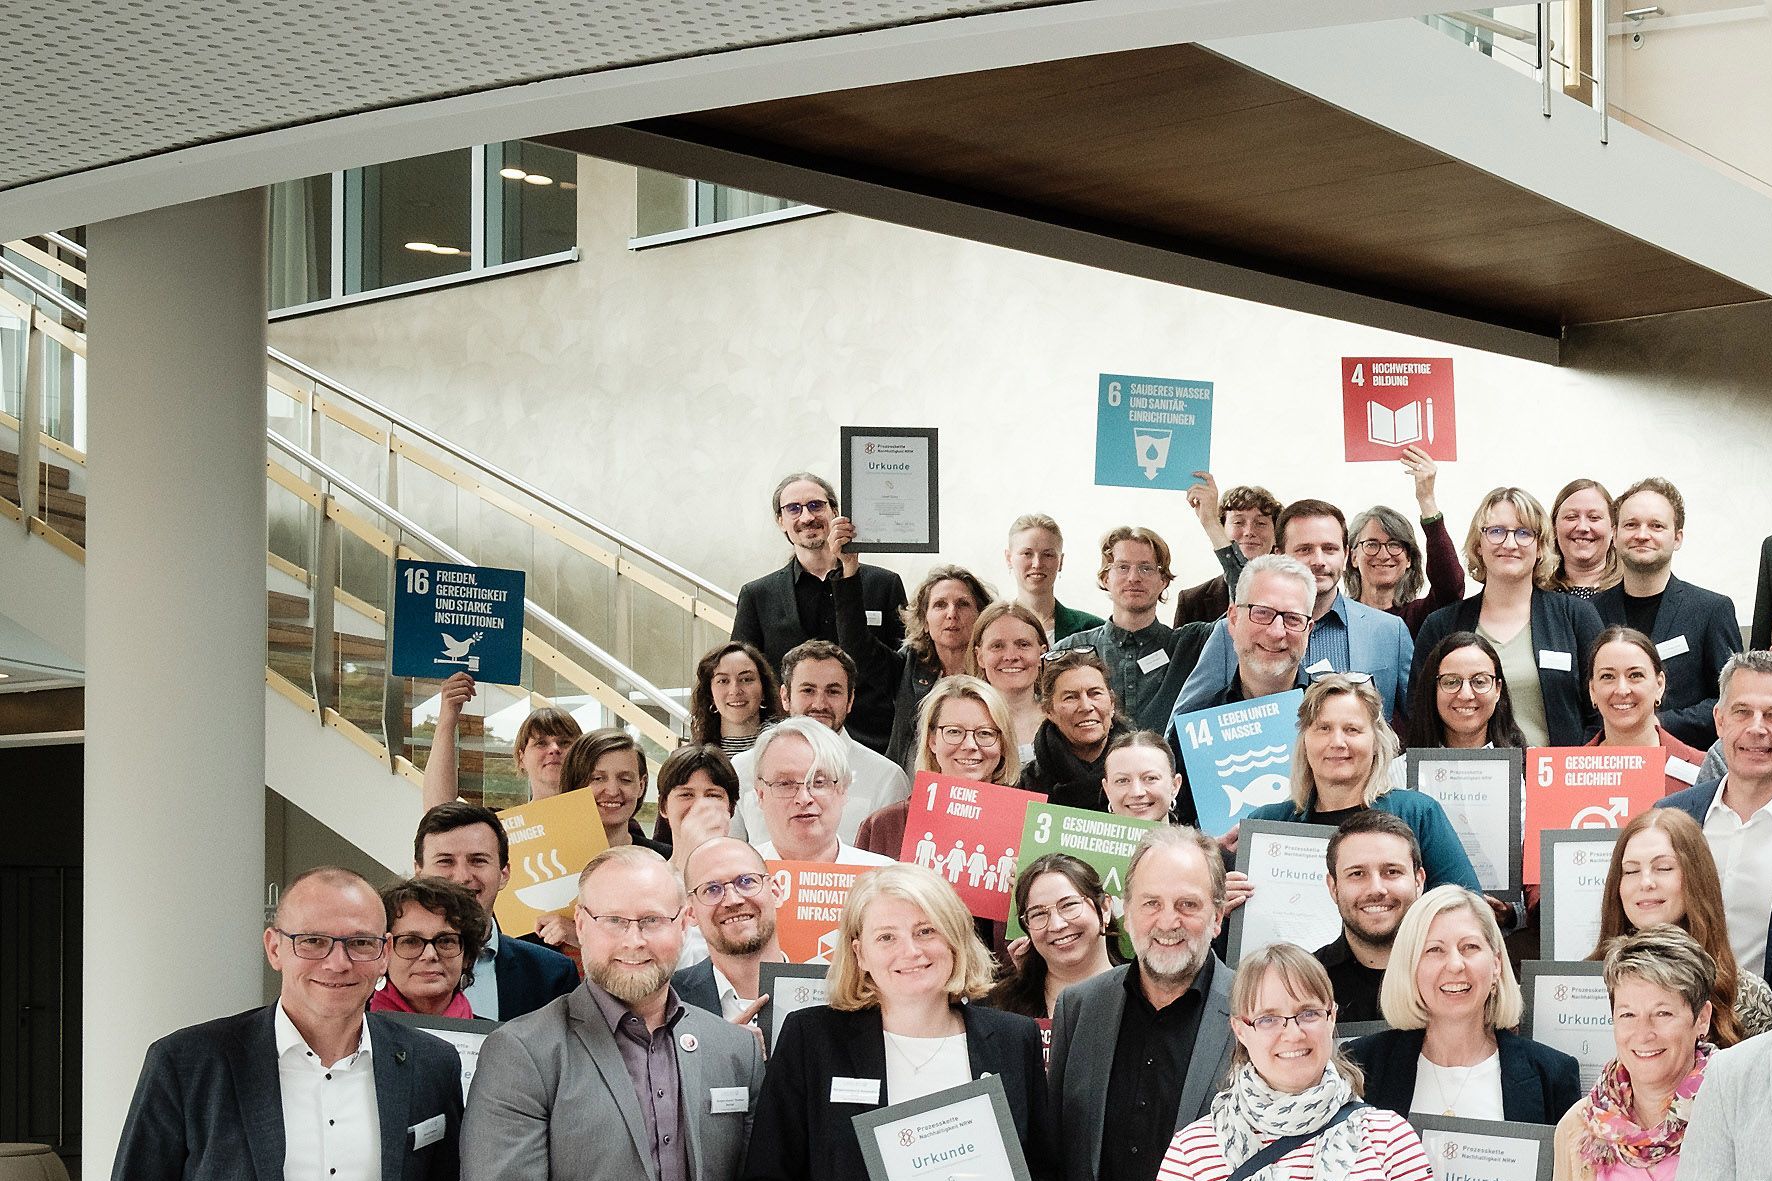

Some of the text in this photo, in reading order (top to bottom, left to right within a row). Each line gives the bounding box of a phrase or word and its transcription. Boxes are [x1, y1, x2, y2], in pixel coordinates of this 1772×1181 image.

[1351, 363, 1365, 387] 4
[1372, 363, 1432, 375] HOCHWERTIGE
[1372, 375, 1409, 387] BILDUNG
[1108, 382, 1121, 407] 6
[1130, 383, 1211, 400] SAUBERES WASSER
[1130, 397, 1188, 412] UND SANITÄR-
[1129, 410, 1195, 426] EINRICHTUNGEN
[868, 462, 910, 471] Urkunde
[404, 568, 430, 595] 16
[436, 570, 478, 586] FRIEDEN,
[436, 584, 508, 602] GERECHTIGKEIT
[435, 598, 493, 614] UND STARKE
[434, 611, 505, 629] INSTITUTIONEN
[1217, 702, 1280, 727] LEBEN UNTER
[1185, 718, 1214, 750] 14
[1221, 722, 1263, 742] WASSER
[1565, 755, 1647, 770] GESCHLECHTER-
[1538, 757, 1553, 787] 5
[1564, 772, 1622, 786] GLEICHHEIT
[927, 782, 938, 811] 1
[949, 786, 979, 803] KEINE
[1439, 792, 1488, 801] Urkunde
[946, 802, 983, 820] ARMUT
[1034, 813, 1053, 844] 3
[1063, 817, 1126, 839] GESUNDHEIT
[1060, 833, 1136, 857] WOHLERGEHEN
[1271, 868, 1323, 881] Urkunde
[774, 869, 792, 902] 9
[798, 889, 849, 905] INNOVATI
[797, 906, 843, 922] INFRAST
[1559, 1013, 1614, 1026] Urkunde
[917, 1116, 959, 1132] Prozesskette
[919, 1124, 960, 1140] Nachhaltigkeit
[912, 1143, 975, 1169] Urkunde
[1463, 1145, 1505, 1155] Prozesskette
